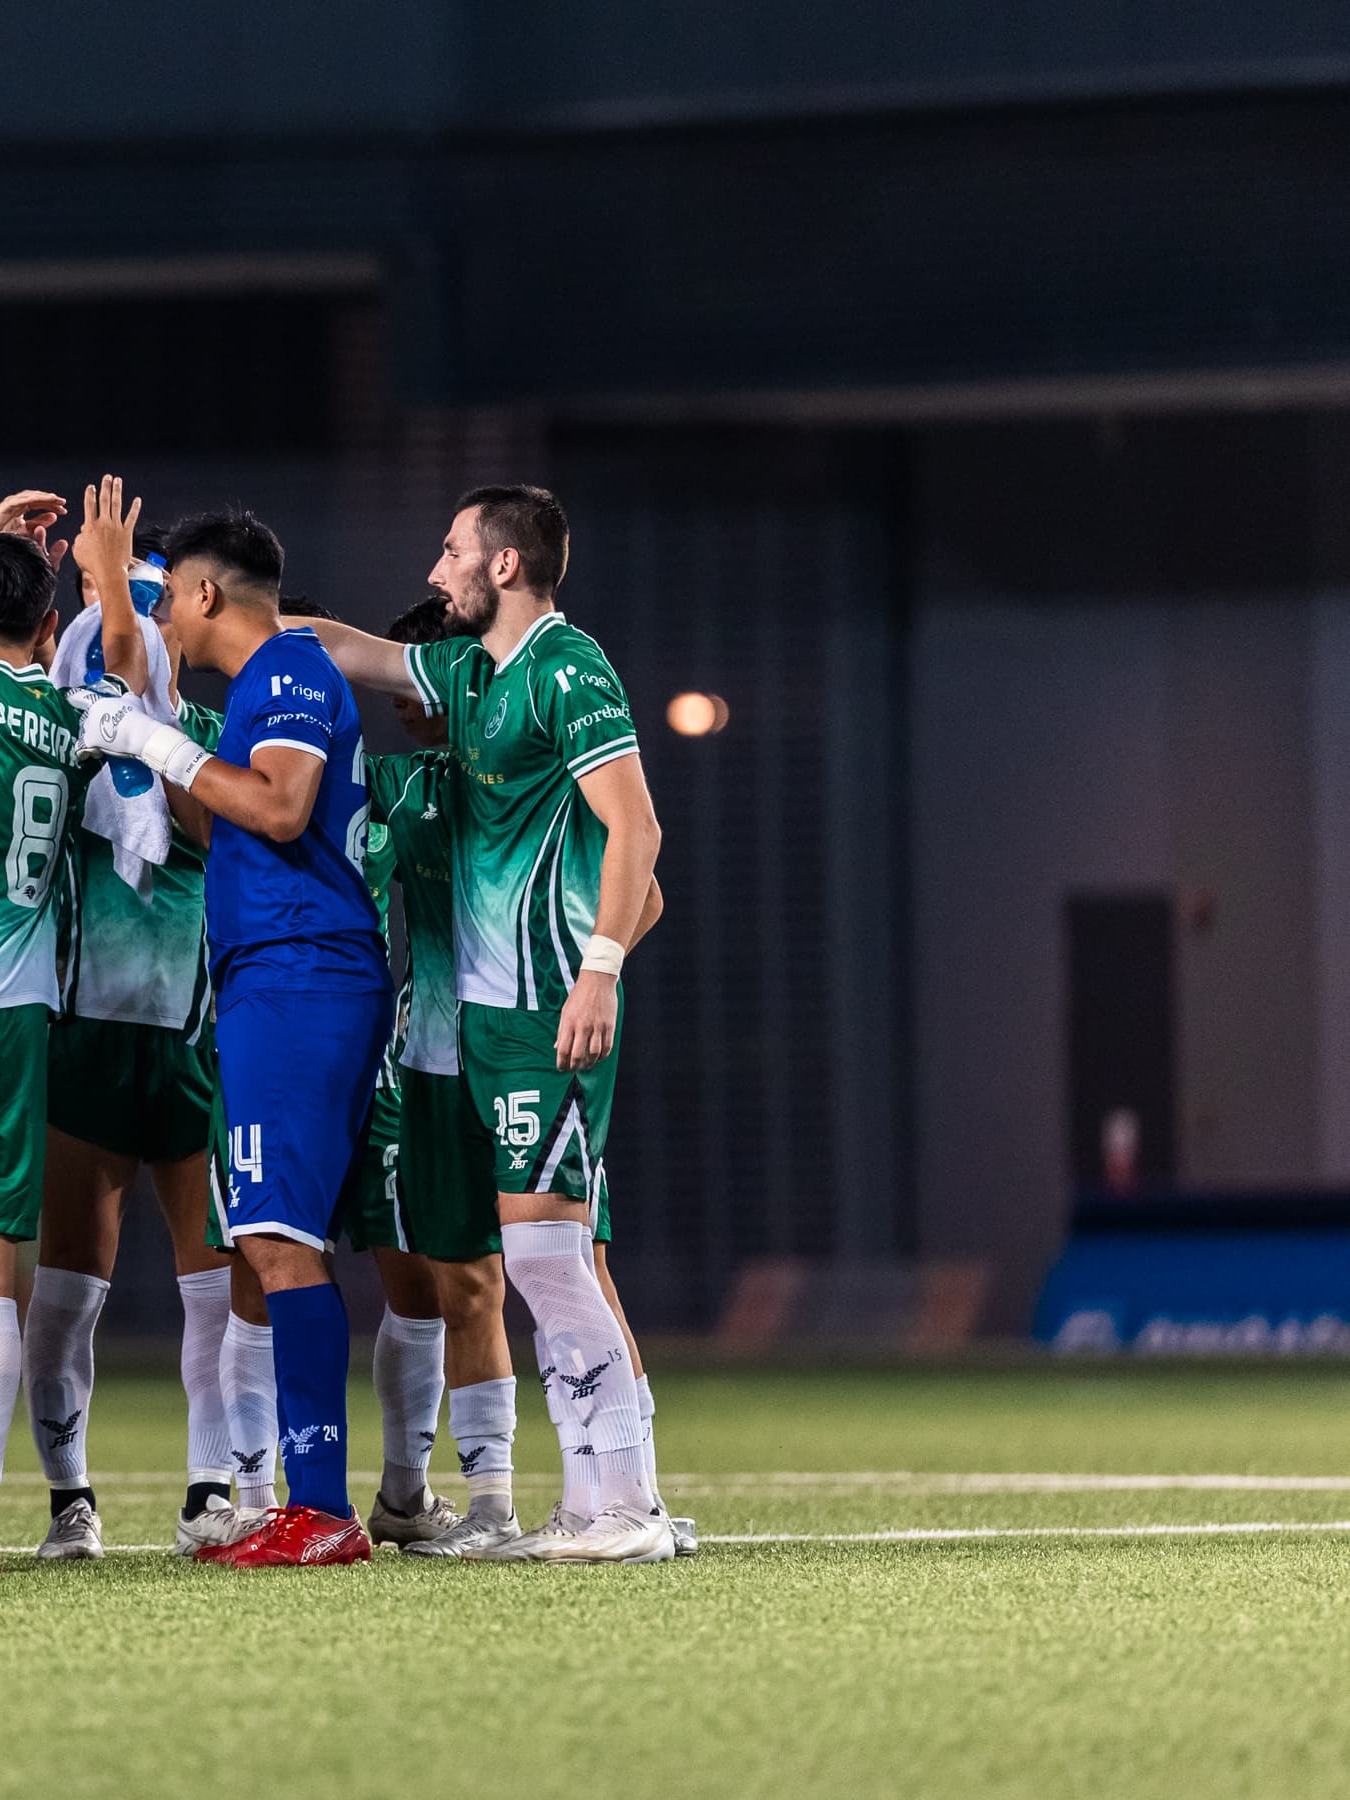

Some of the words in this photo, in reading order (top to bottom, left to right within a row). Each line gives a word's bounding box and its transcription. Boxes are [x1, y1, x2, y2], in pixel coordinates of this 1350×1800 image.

[292, 683, 326, 703] rigel
[5, 765, 70, 909] 8
[228, 1123, 263, 1188] 4
[607, 1348, 622, 1363] 15
[322, 1424, 339, 1442] 24
